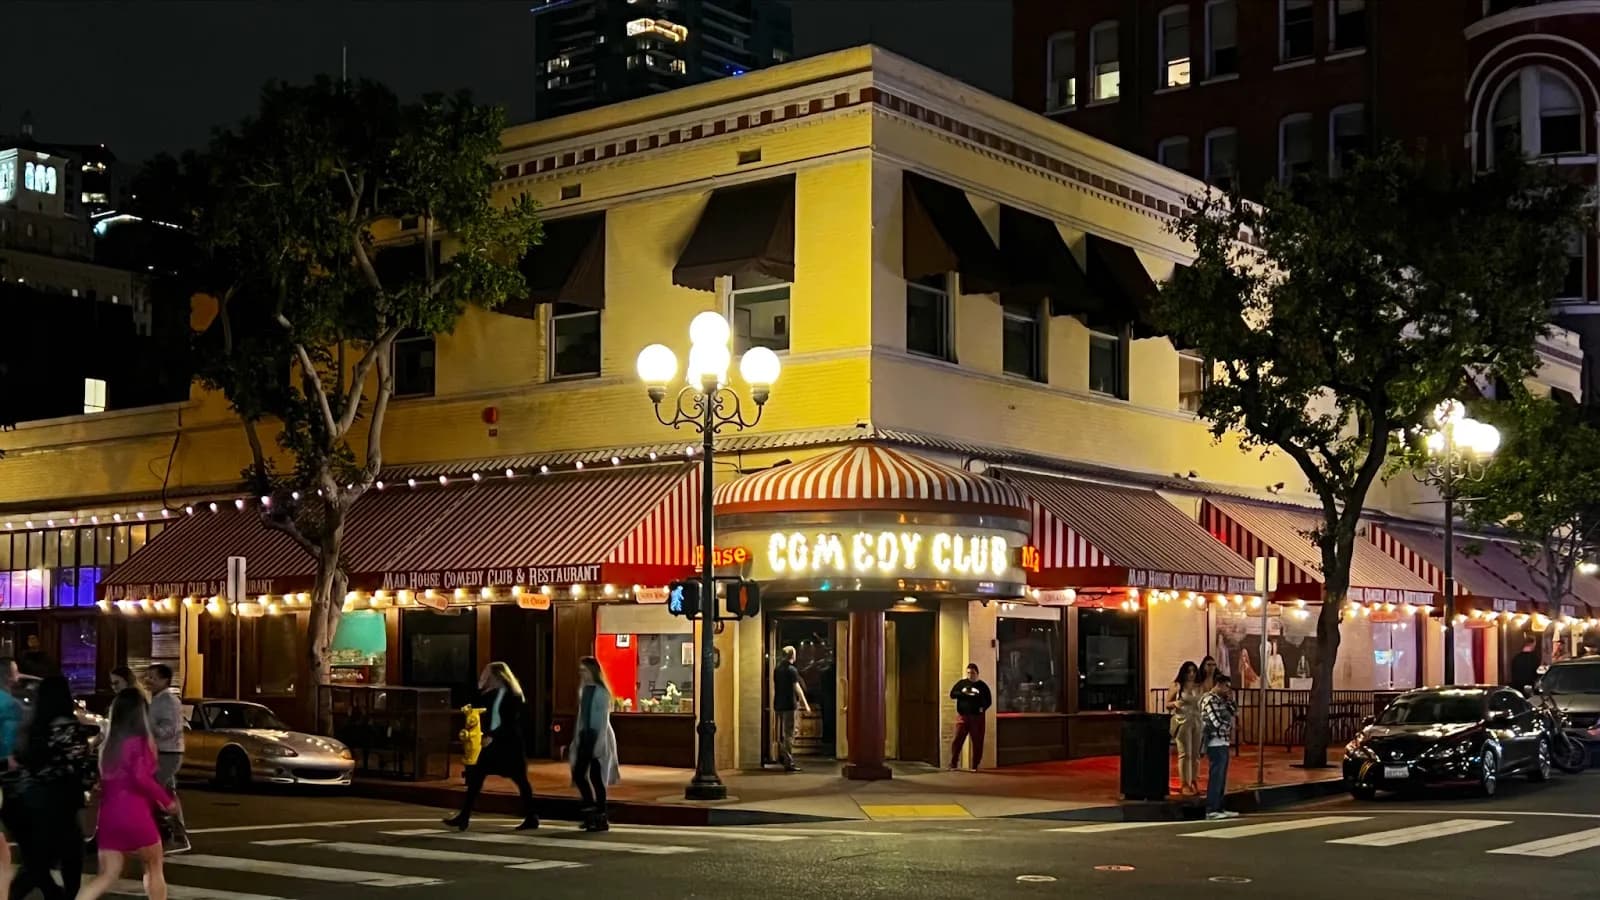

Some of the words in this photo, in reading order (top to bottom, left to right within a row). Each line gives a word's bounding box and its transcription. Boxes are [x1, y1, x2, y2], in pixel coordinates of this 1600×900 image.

[768, 531, 921, 572] COMEDY
[931, 532, 1008, 576] CLUB
[410, 572, 441, 589] HOUSE
[444, 570, 484, 589] COMEDY
[487, 569, 513, 587] CLUB
[516, 568, 525, 583] &
[529, 565, 600, 586] RESTAURANT
